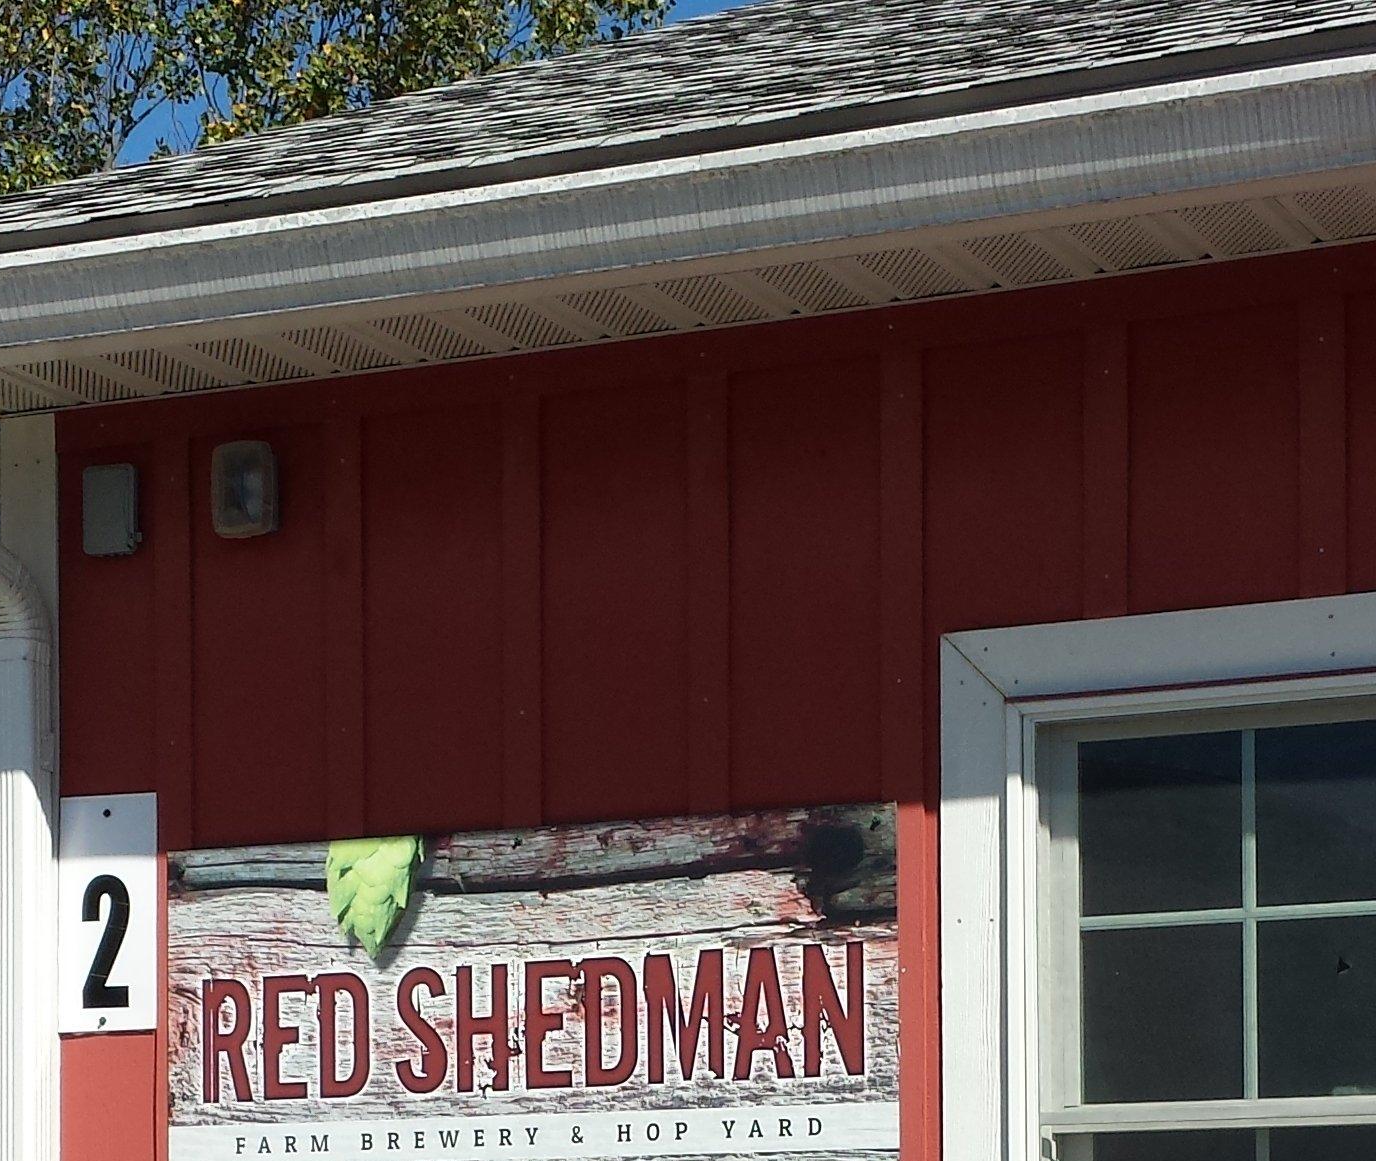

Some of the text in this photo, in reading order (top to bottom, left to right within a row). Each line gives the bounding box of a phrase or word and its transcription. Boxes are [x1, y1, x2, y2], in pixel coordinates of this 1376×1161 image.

[82, 874, 130, 1010] 2
[201, 941, 866, 1104] RED SHEDMAN
[235, 1117, 823, 1155] FARM BREWERY & HOP YARD
